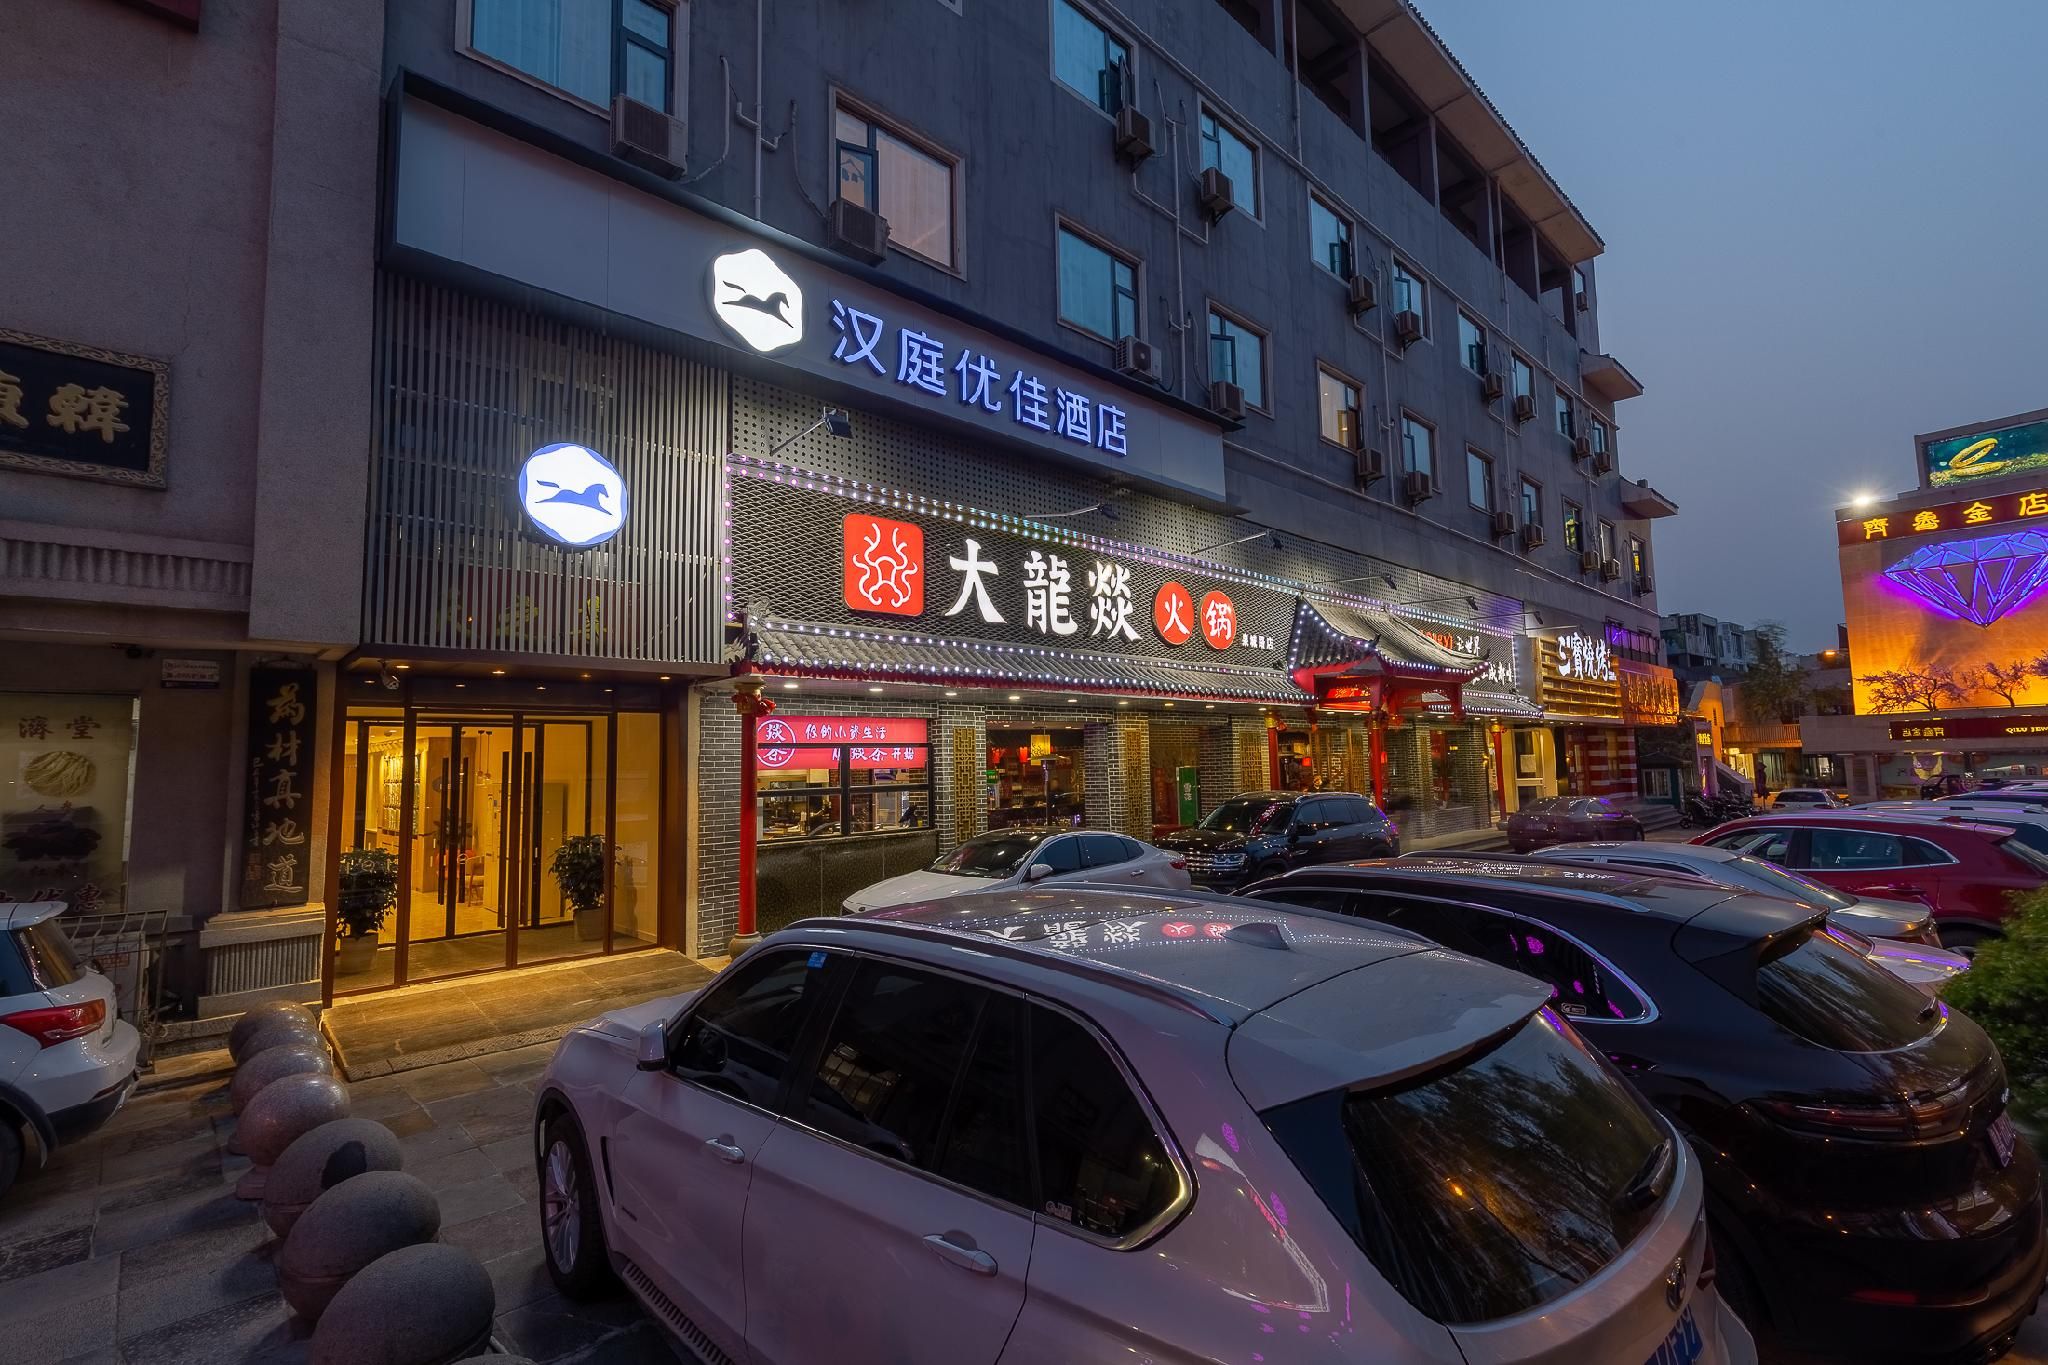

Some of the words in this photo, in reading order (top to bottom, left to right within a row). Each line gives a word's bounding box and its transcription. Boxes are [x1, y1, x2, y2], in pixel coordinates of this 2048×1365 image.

[831, 298, 1127, 457] 汉庭优佳酒店
[944, 538, 1141, 642] 大龍燚
[1163, 592, 1232, 640] 火锅
[804, 723, 888, 740] 你的小资生活
